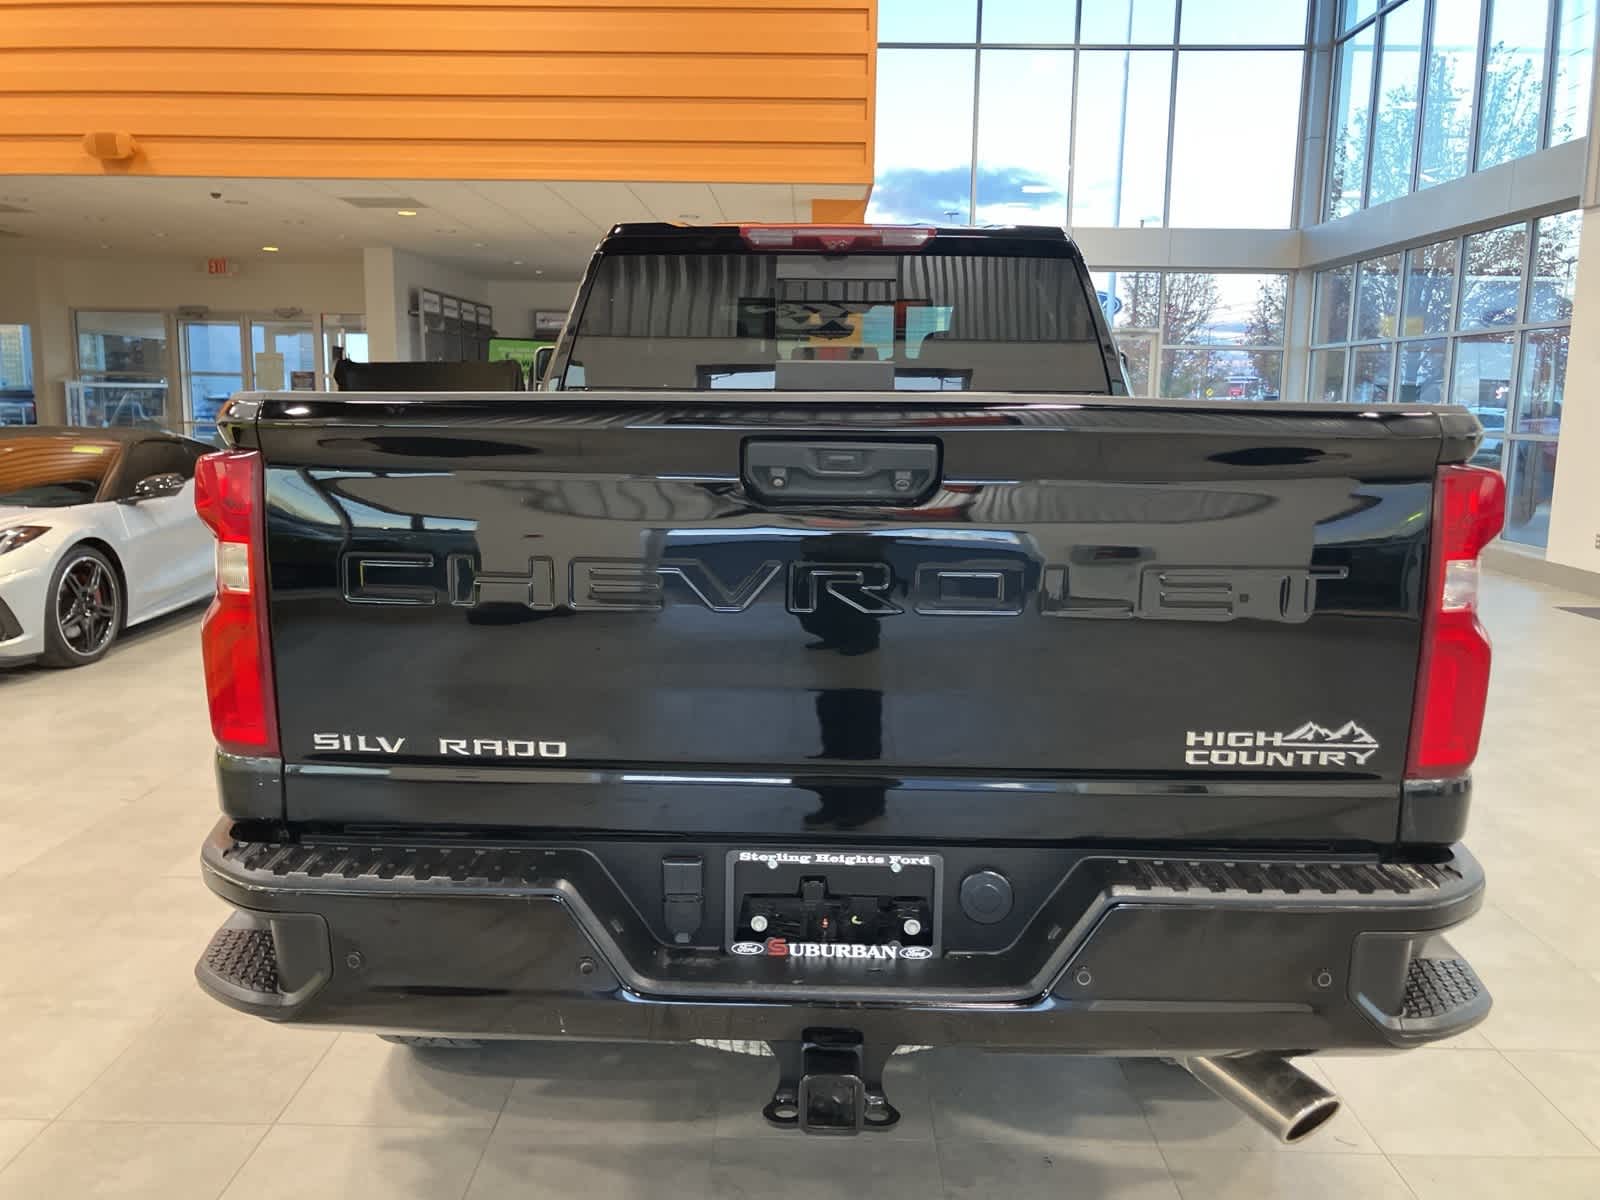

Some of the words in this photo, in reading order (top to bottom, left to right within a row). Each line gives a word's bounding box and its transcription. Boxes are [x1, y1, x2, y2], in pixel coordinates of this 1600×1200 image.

[341, 552, 1349, 623] CHEVROLET
[1186, 731, 1283, 747] HIGH
[1185, 750, 1376, 767] COUNTRY
[739, 852, 811, 864] Sterling
[815, 854, 885, 865] Heights
[889, 855, 930, 866] Ford
[767, 938, 897, 959] SUBURBAN
